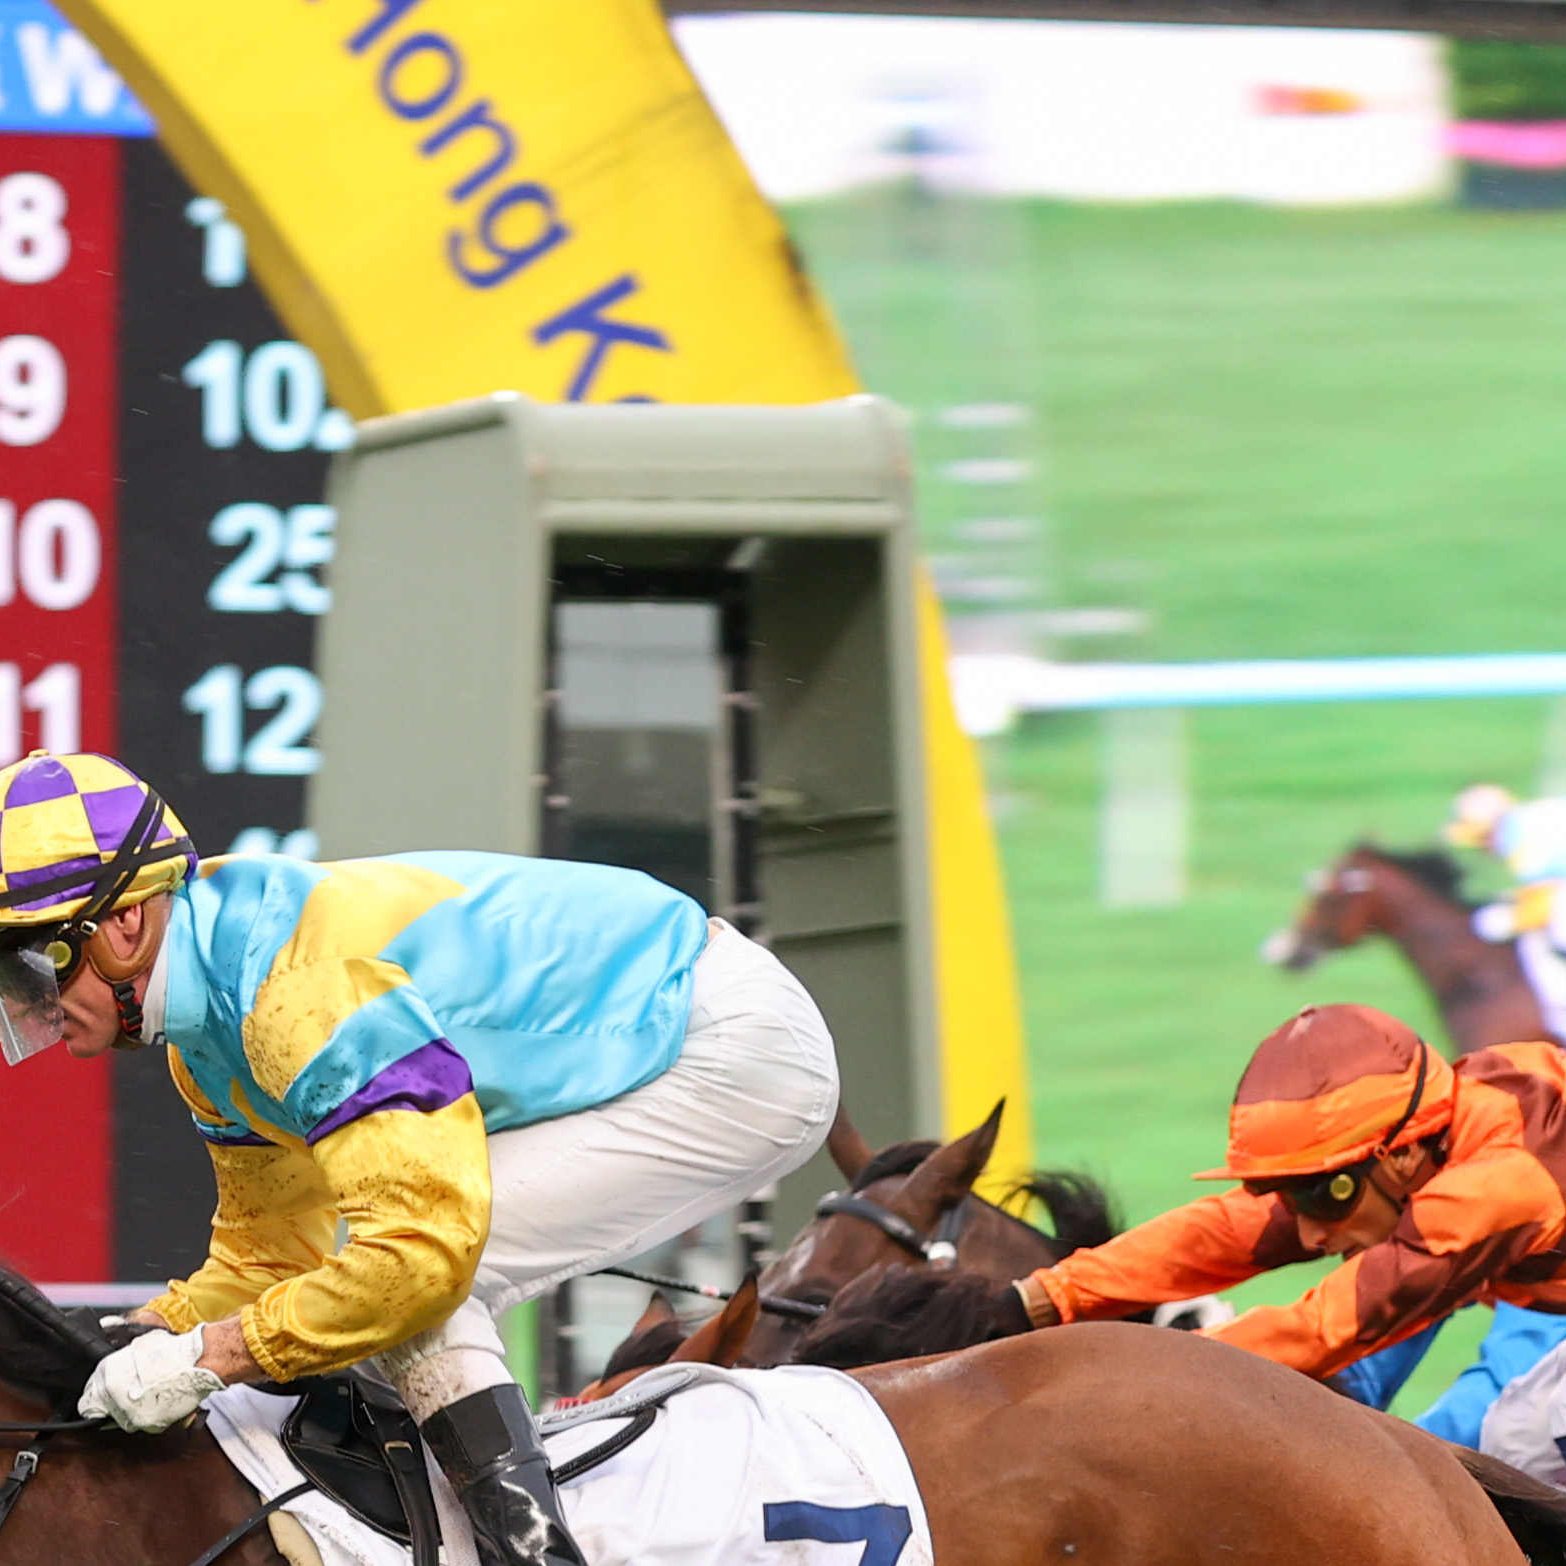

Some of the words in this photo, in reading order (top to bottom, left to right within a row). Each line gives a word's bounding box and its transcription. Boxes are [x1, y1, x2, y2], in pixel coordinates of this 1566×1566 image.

[16, 22, 127, 118] W
[529, 272, 676, 404] K
[184, 665, 322, 775] 12
